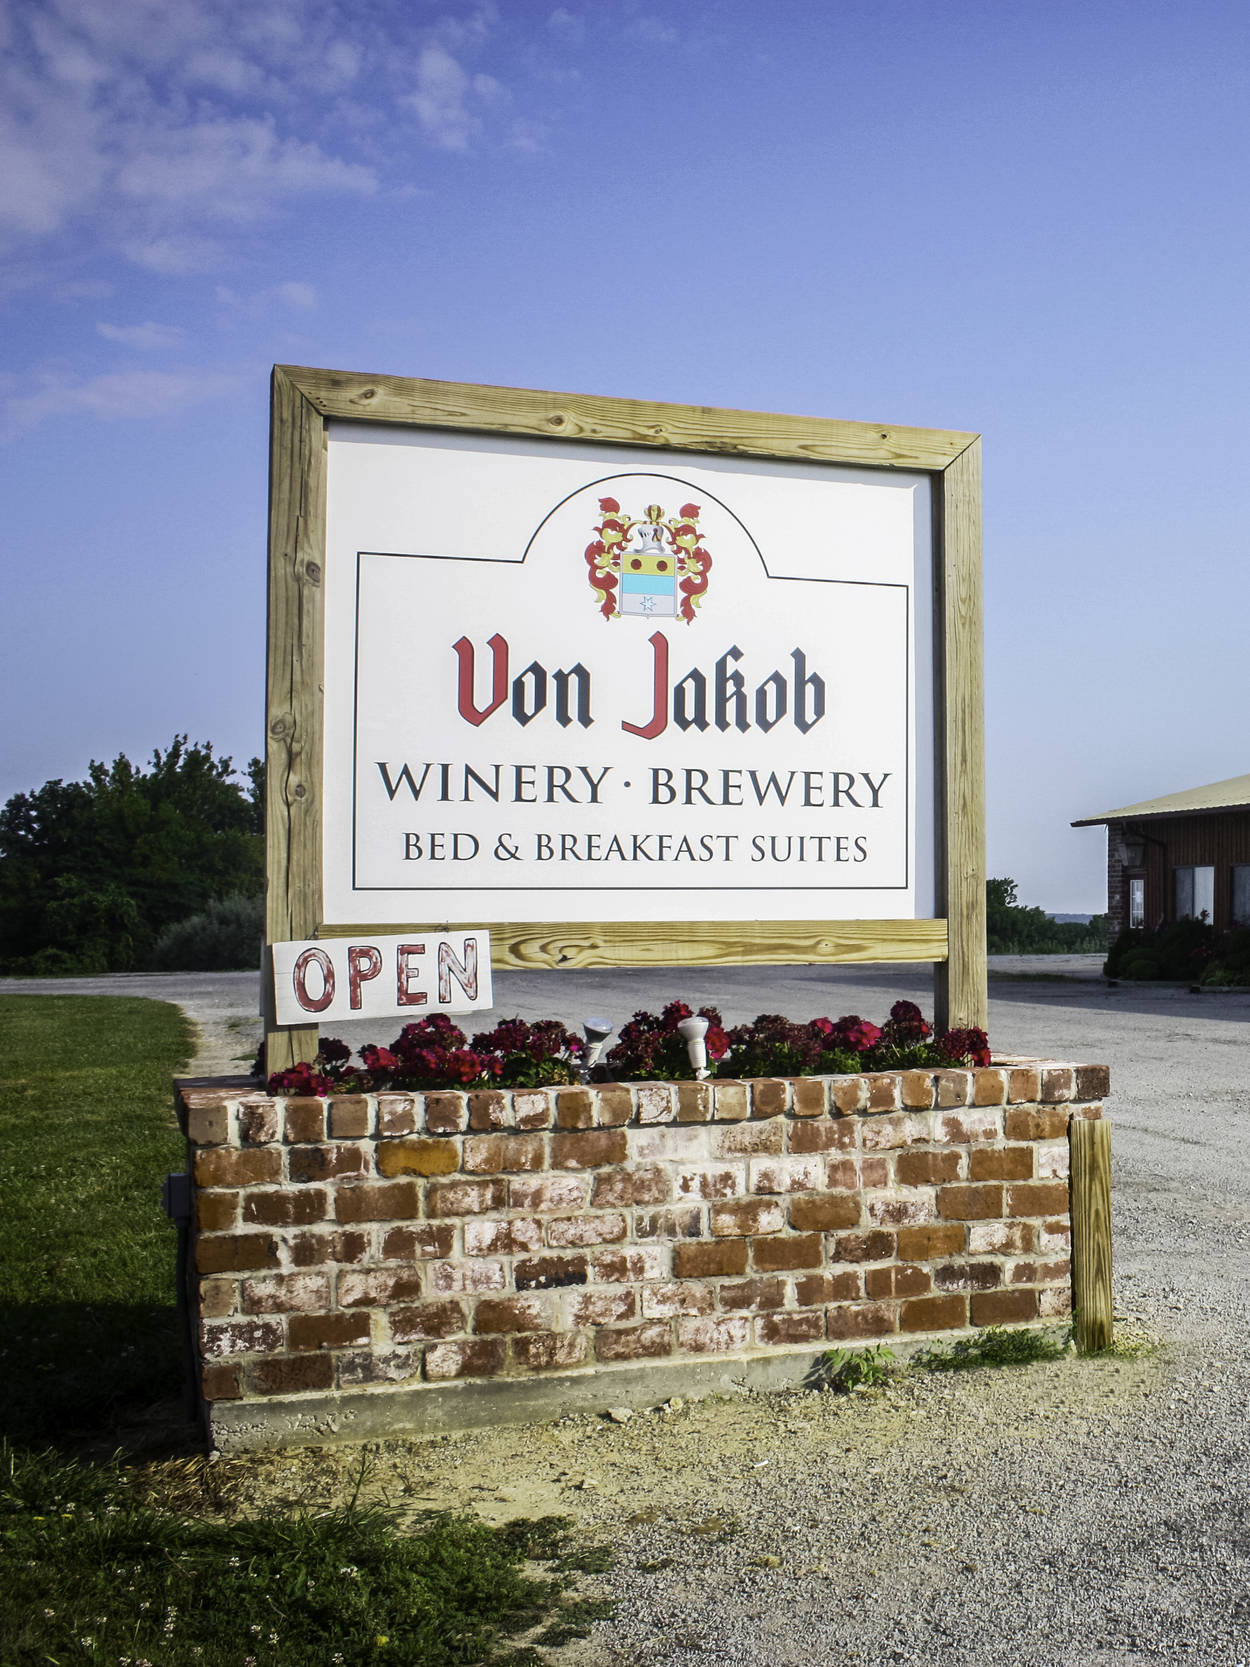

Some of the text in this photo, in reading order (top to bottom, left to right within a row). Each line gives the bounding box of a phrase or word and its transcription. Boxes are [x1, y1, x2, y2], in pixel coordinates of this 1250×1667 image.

[452, 630, 826, 740] Von Jakob
[375, 761, 893, 809] WINERY BREWERY
[402, 832, 869, 863] BED & BREAKFAST SUITES
[293, 937, 478, 1012] OPEN
